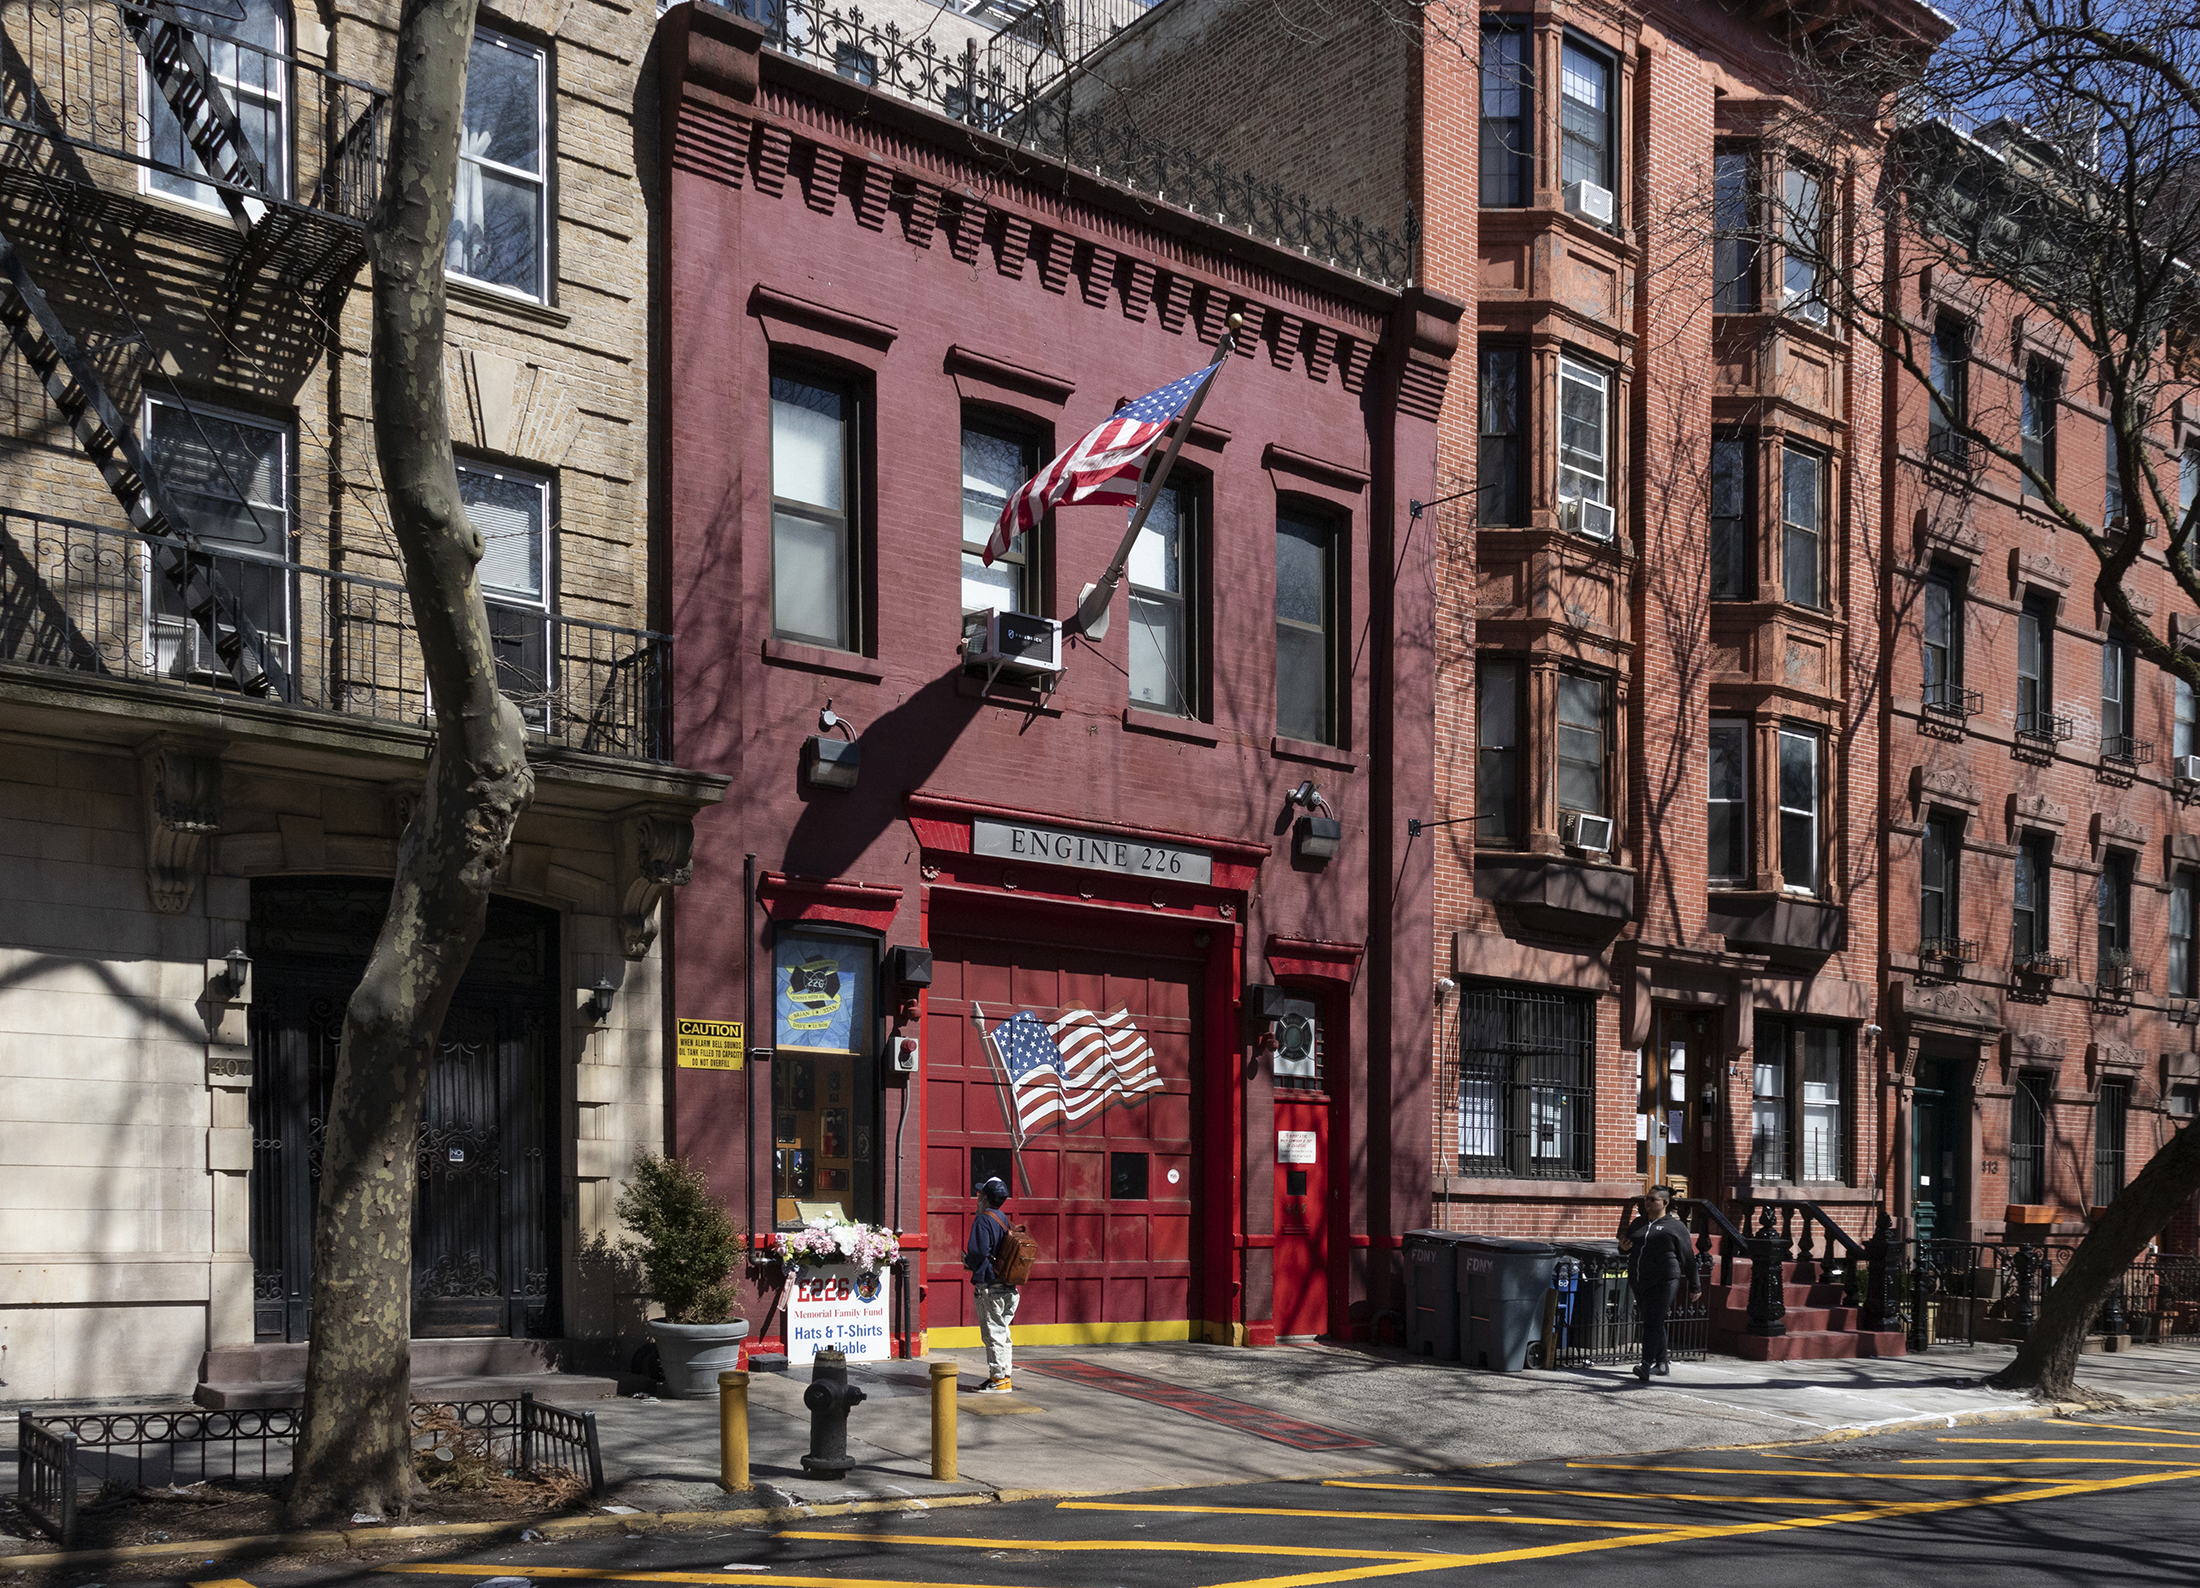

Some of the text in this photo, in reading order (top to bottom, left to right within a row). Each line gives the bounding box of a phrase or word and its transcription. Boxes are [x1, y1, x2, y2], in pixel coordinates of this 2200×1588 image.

[1010, 828, 1181, 874] ENGINE 226
[822, 1005, 837, 1014] STAN
[681, 1022, 739, 1037] CAUTION
[680, 1038, 742, 1049] WHEN ALARM BELL SOUNDS
[687, 1048, 699, 1057] TANK
[700, 1048, 714, 1058] FILLED
[715, 1049, 721, 1058] TO
[722, 1050, 743, 1059] CAPACITY
[211, 1058, 248, 1077] 407
[692, 1057, 730, 1067] DO NOT OVERFILL
[1411, 1248, 1437, 1263] FDNY
[1466, 1257, 1494, 1273] FDNY
[797, 1277, 850, 1303] E226
[794, 1307, 883, 1319] Memorial Family Fund
[795, 1324, 883, 1340] Hats & T-Shirts
